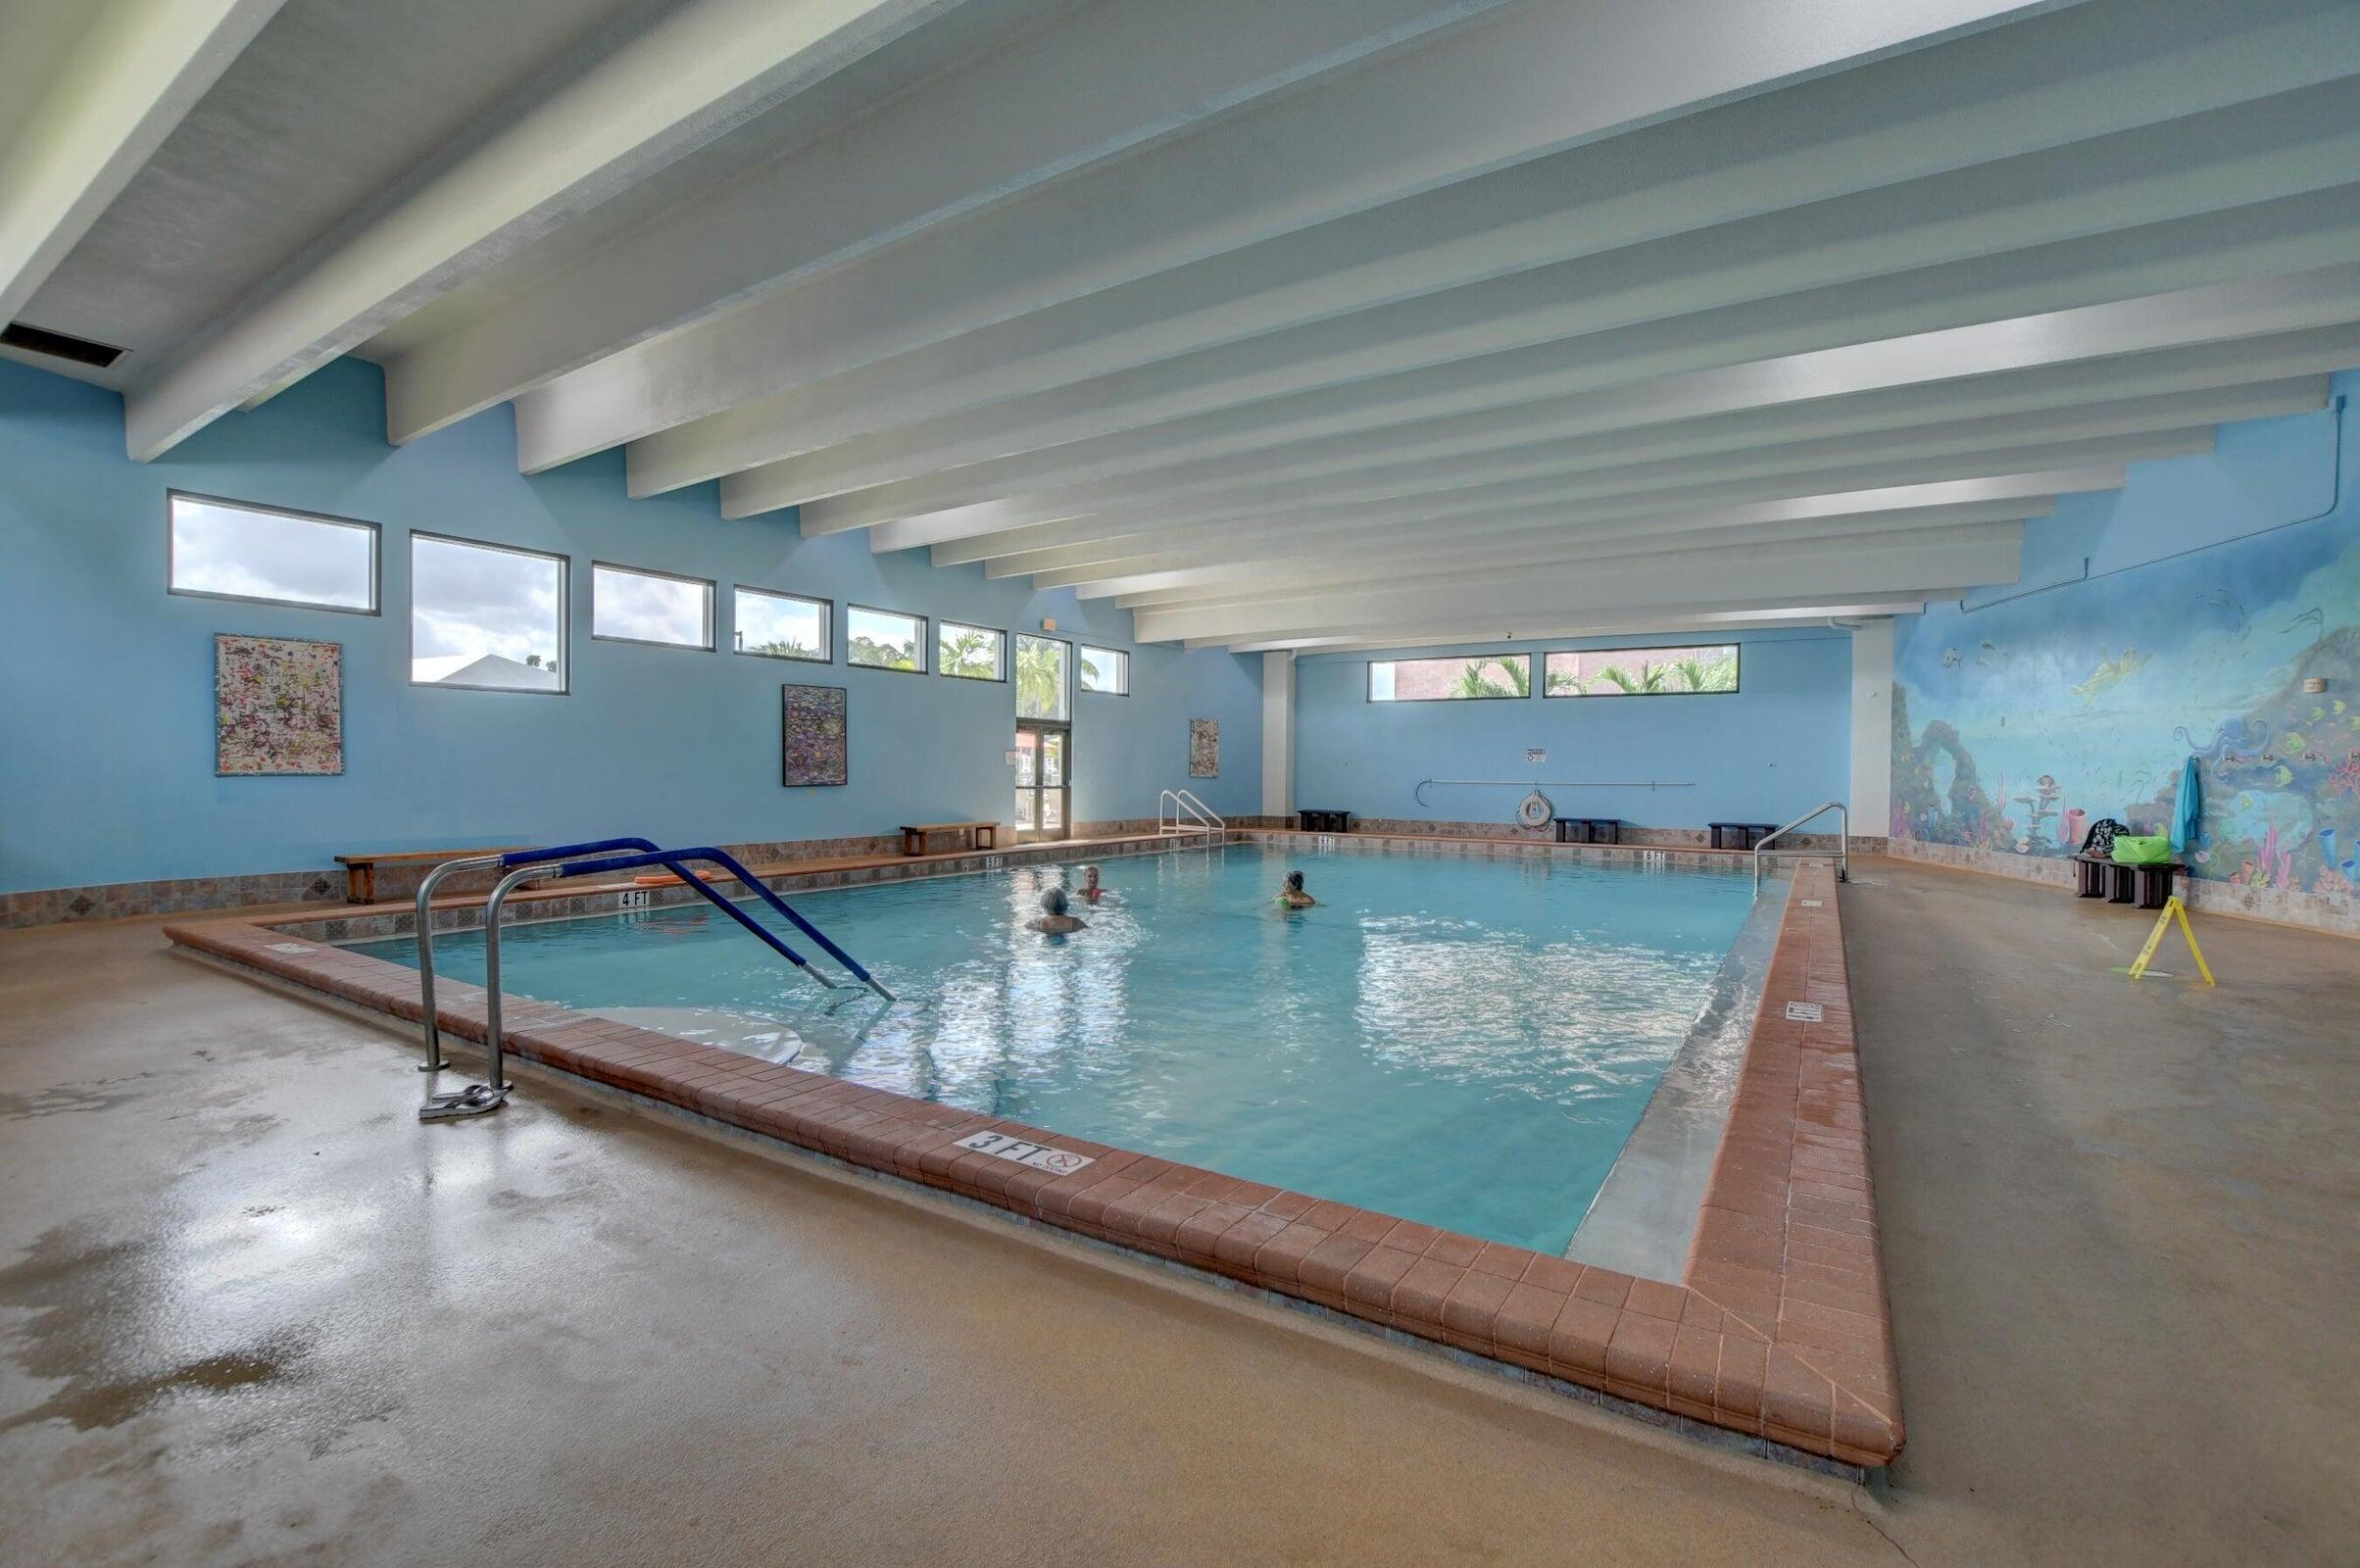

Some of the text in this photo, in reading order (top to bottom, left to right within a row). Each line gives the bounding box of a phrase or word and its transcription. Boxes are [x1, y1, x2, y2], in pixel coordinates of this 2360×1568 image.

[622, 891, 649, 906] 4 FT
[968, 1135, 1053, 1160] 3 FT
